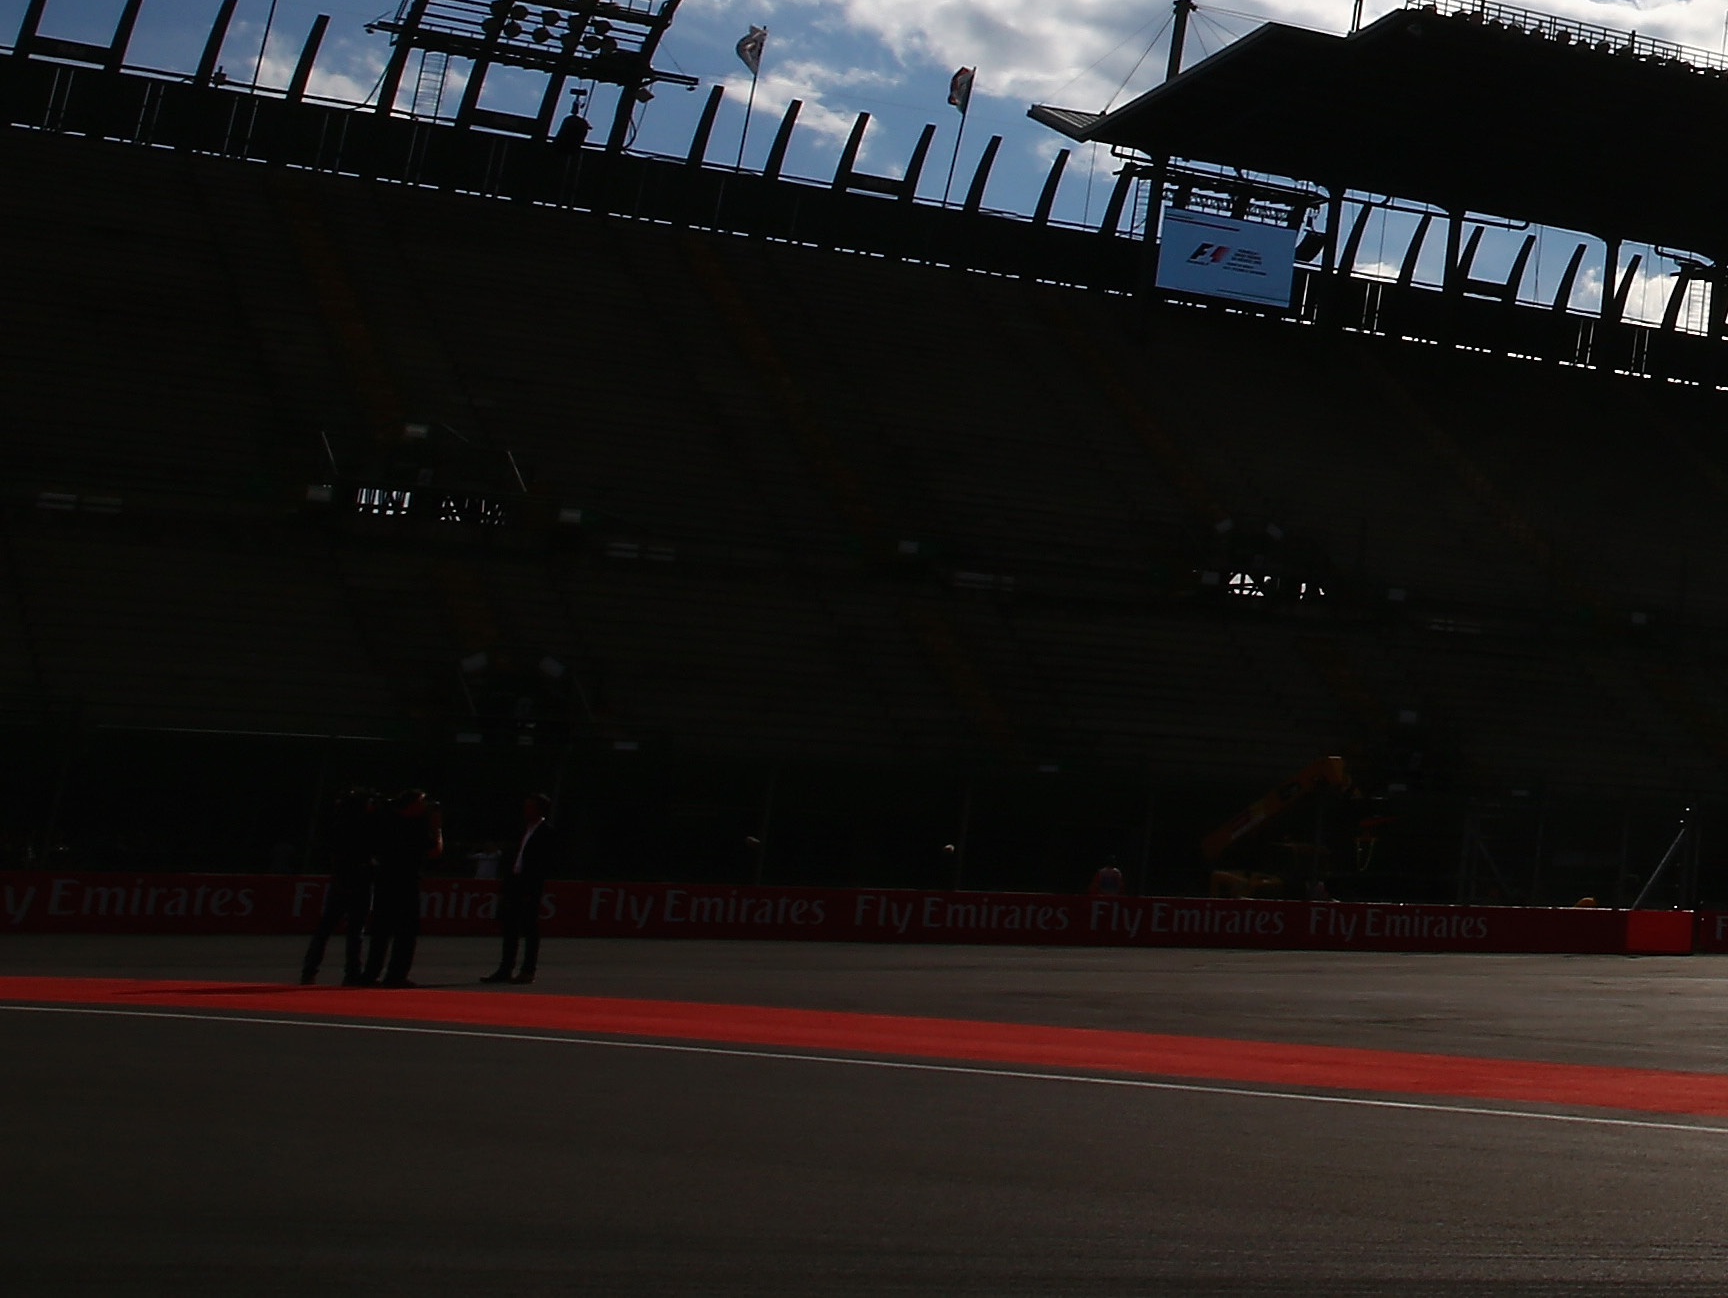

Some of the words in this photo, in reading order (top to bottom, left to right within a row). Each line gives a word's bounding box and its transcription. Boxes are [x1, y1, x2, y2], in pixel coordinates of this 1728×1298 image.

[47, 878, 255, 917] Emirates
[291, 882, 333, 918] Fl
[588, 887, 655, 929] Fly
[663, 889, 826, 925] Emirates
[854, 895, 914, 934] Fly
[922, 897, 1070, 931] Emirates
[1089, 901, 1143, 938] Fly
[1151, 902, 1285, 934] Emirates
[1309, 906, 1358, 942] Fly
[1365, 908, 1489, 938] Emirates
